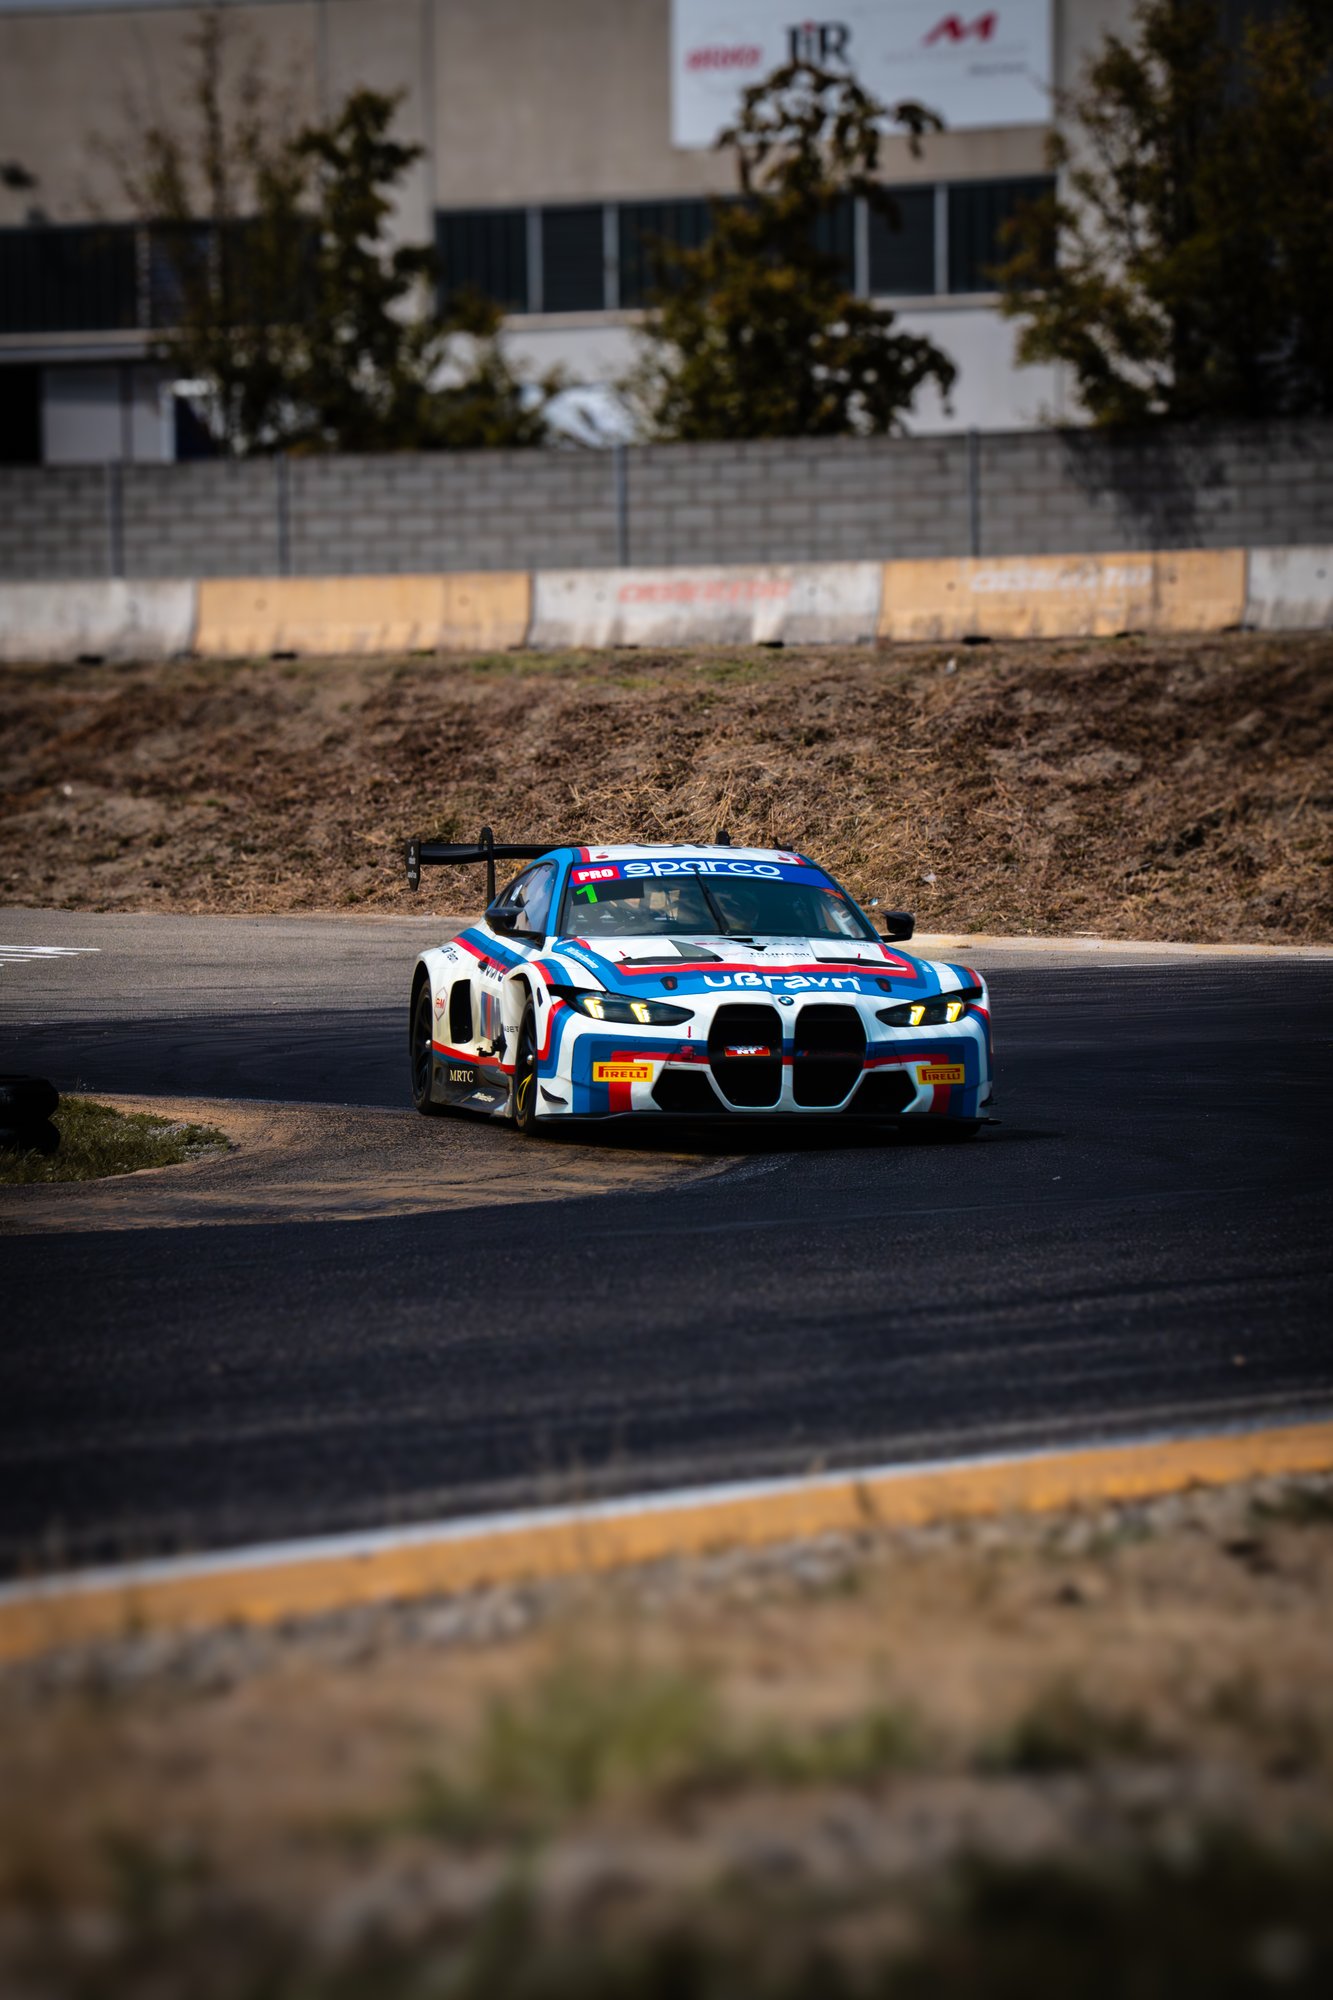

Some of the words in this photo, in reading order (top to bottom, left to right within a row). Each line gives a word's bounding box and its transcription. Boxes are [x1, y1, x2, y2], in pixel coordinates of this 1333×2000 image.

[577, 868, 615, 881] PRO
[623, 860, 781, 877] sparco
[576, 884, 599, 904] 1
[449, 1069, 474, 1083] MRTC
[598, 1065, 648, 1079] PIRELLI
[921, 1067, 961, 1081] PIRELLI
